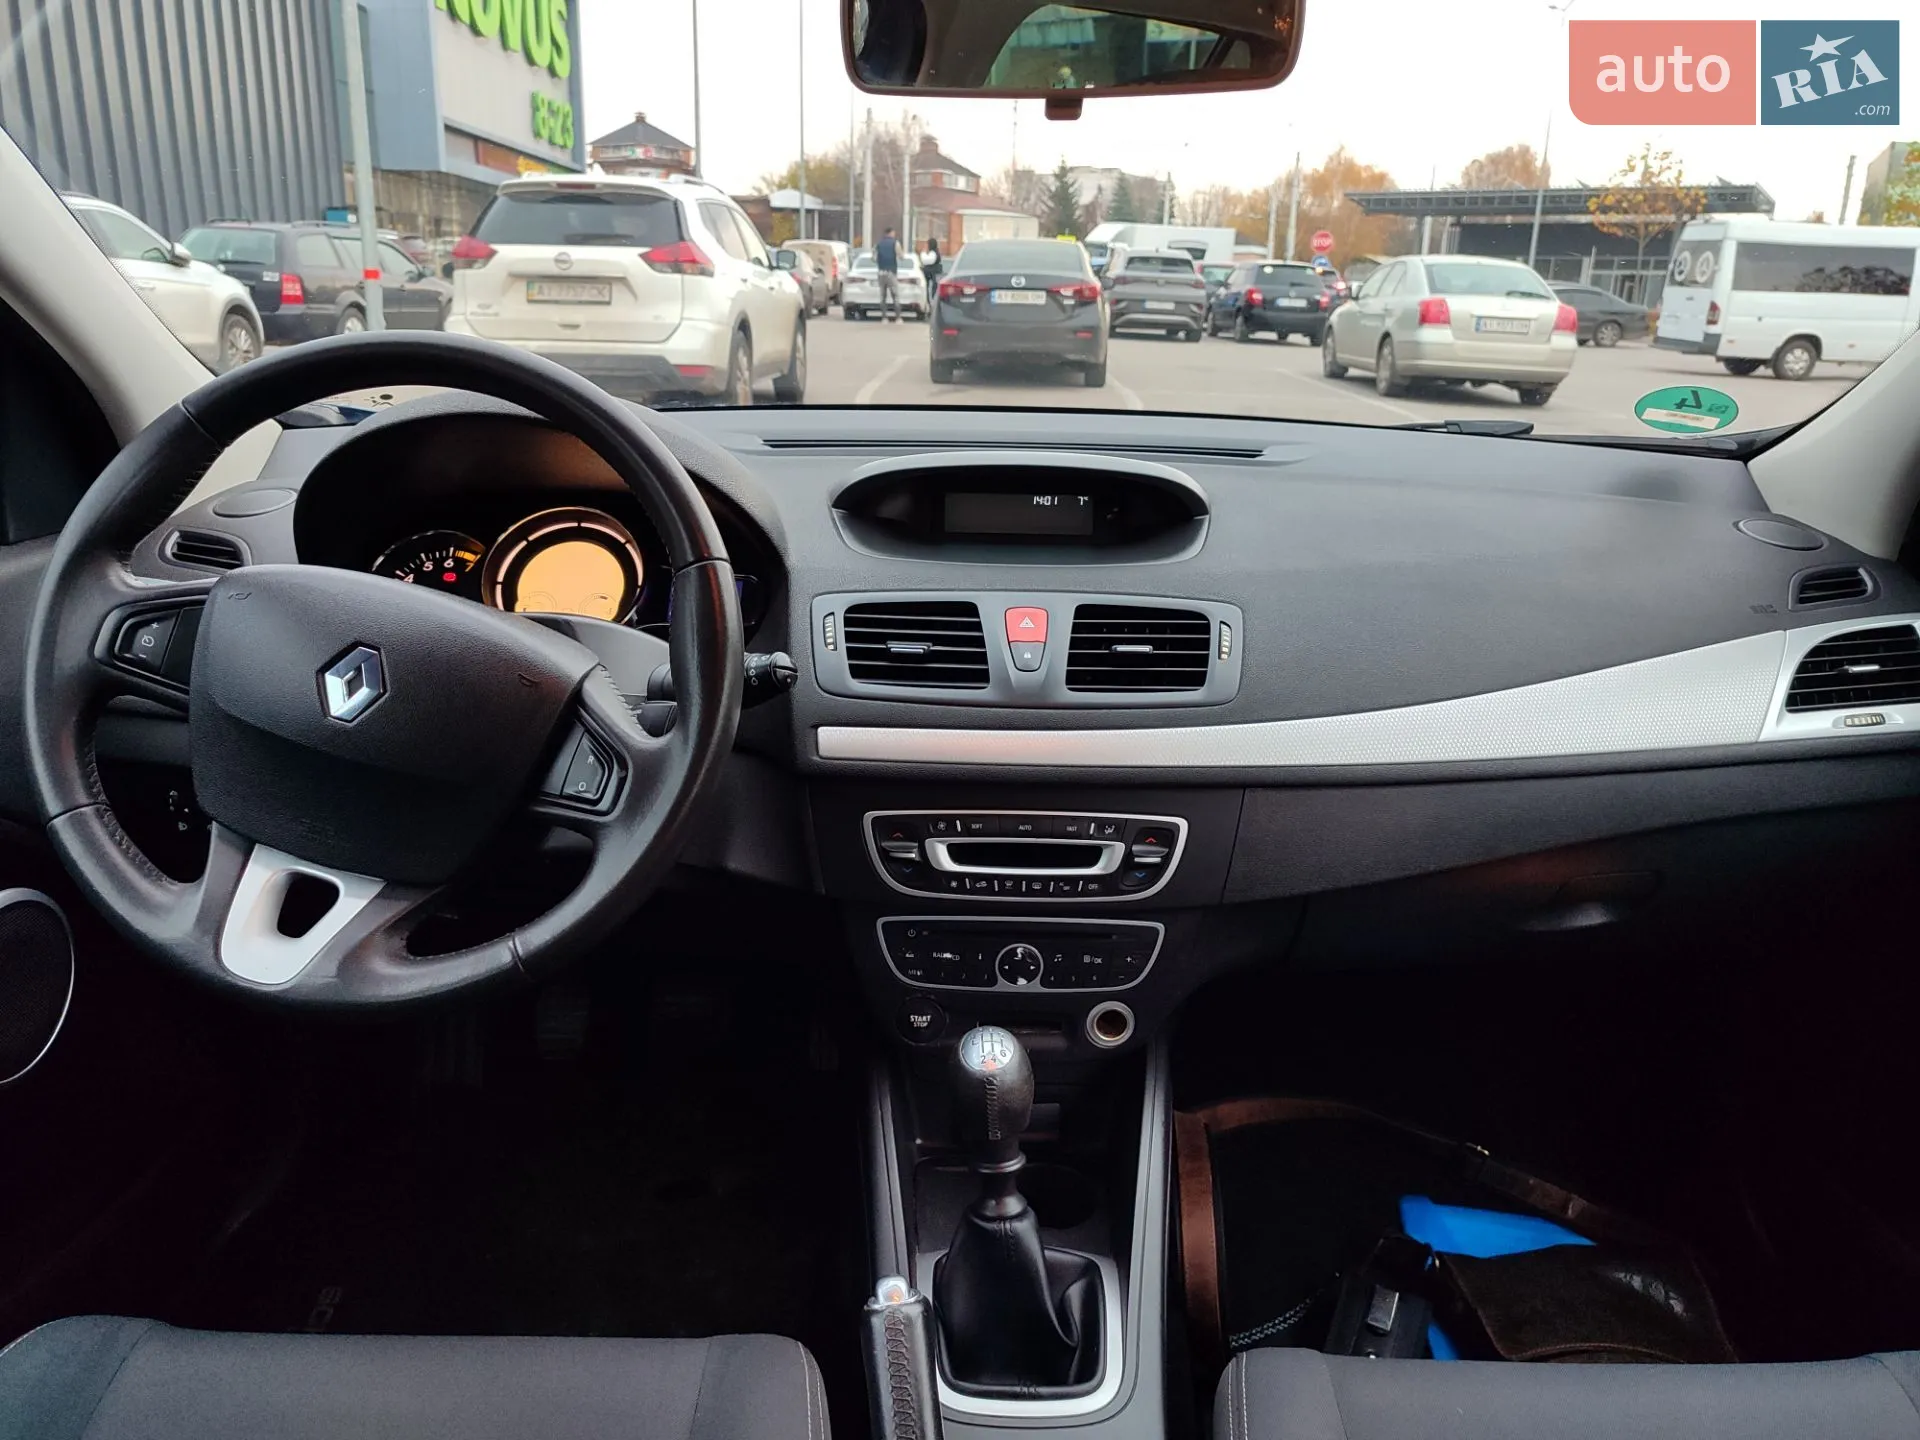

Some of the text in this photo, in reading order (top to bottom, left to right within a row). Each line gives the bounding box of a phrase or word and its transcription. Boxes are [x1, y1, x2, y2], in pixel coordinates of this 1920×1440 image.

[434, 0, 572, 79] VUS
[403, 558, 475, 583] 4 5 6 7
[910, 1014, 932, 1023] START
